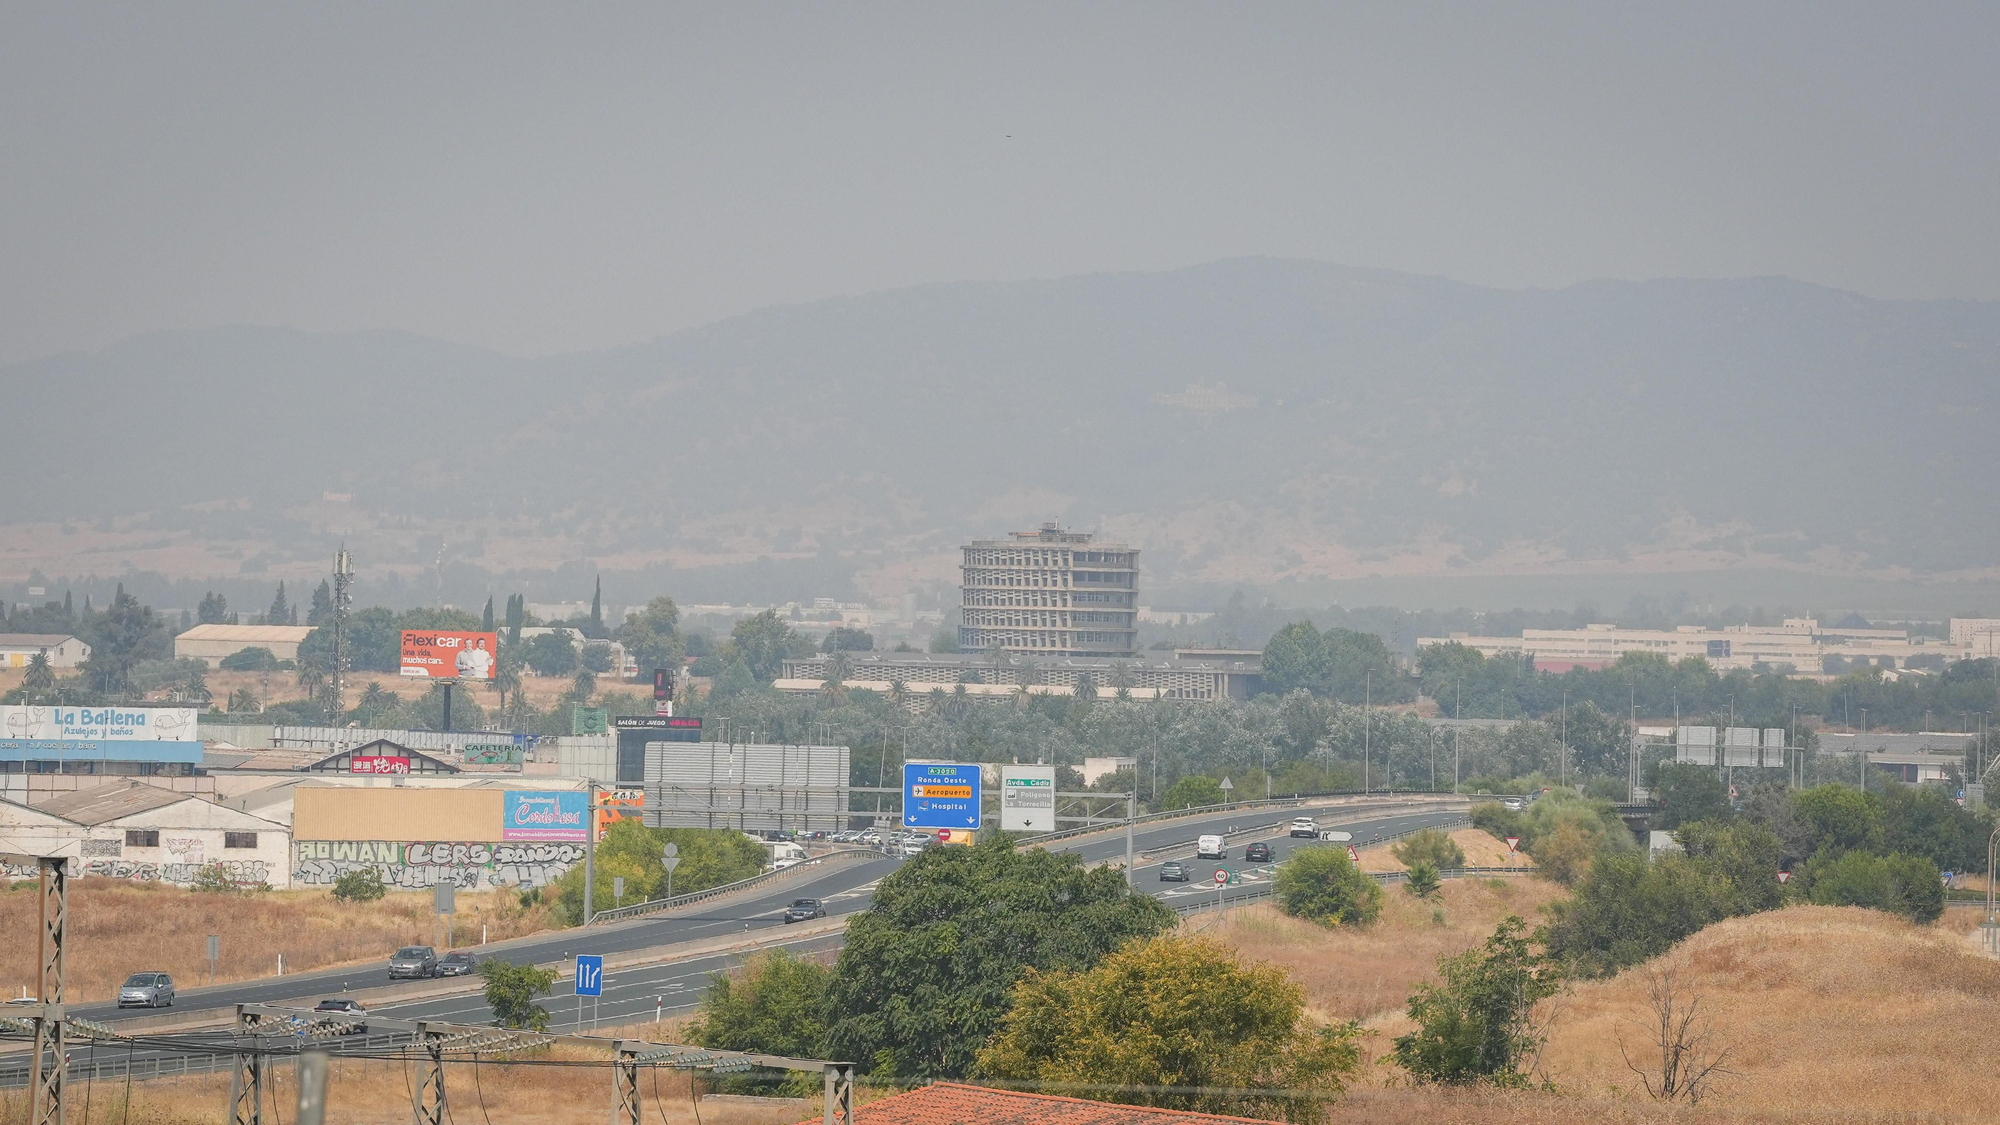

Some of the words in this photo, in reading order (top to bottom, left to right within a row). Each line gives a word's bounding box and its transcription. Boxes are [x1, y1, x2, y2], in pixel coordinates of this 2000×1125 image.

[403, 634, 462, 648] Flexicar
[54, 709, 75, 725] La
[81, 709, 146, 726] Ballena
[64, 727, 98, 738] Azulejos
[101, 729, 107, 738] y
[110, 727, 134, 736] baños
[926, 788, 971, 796] Aeropuerto
